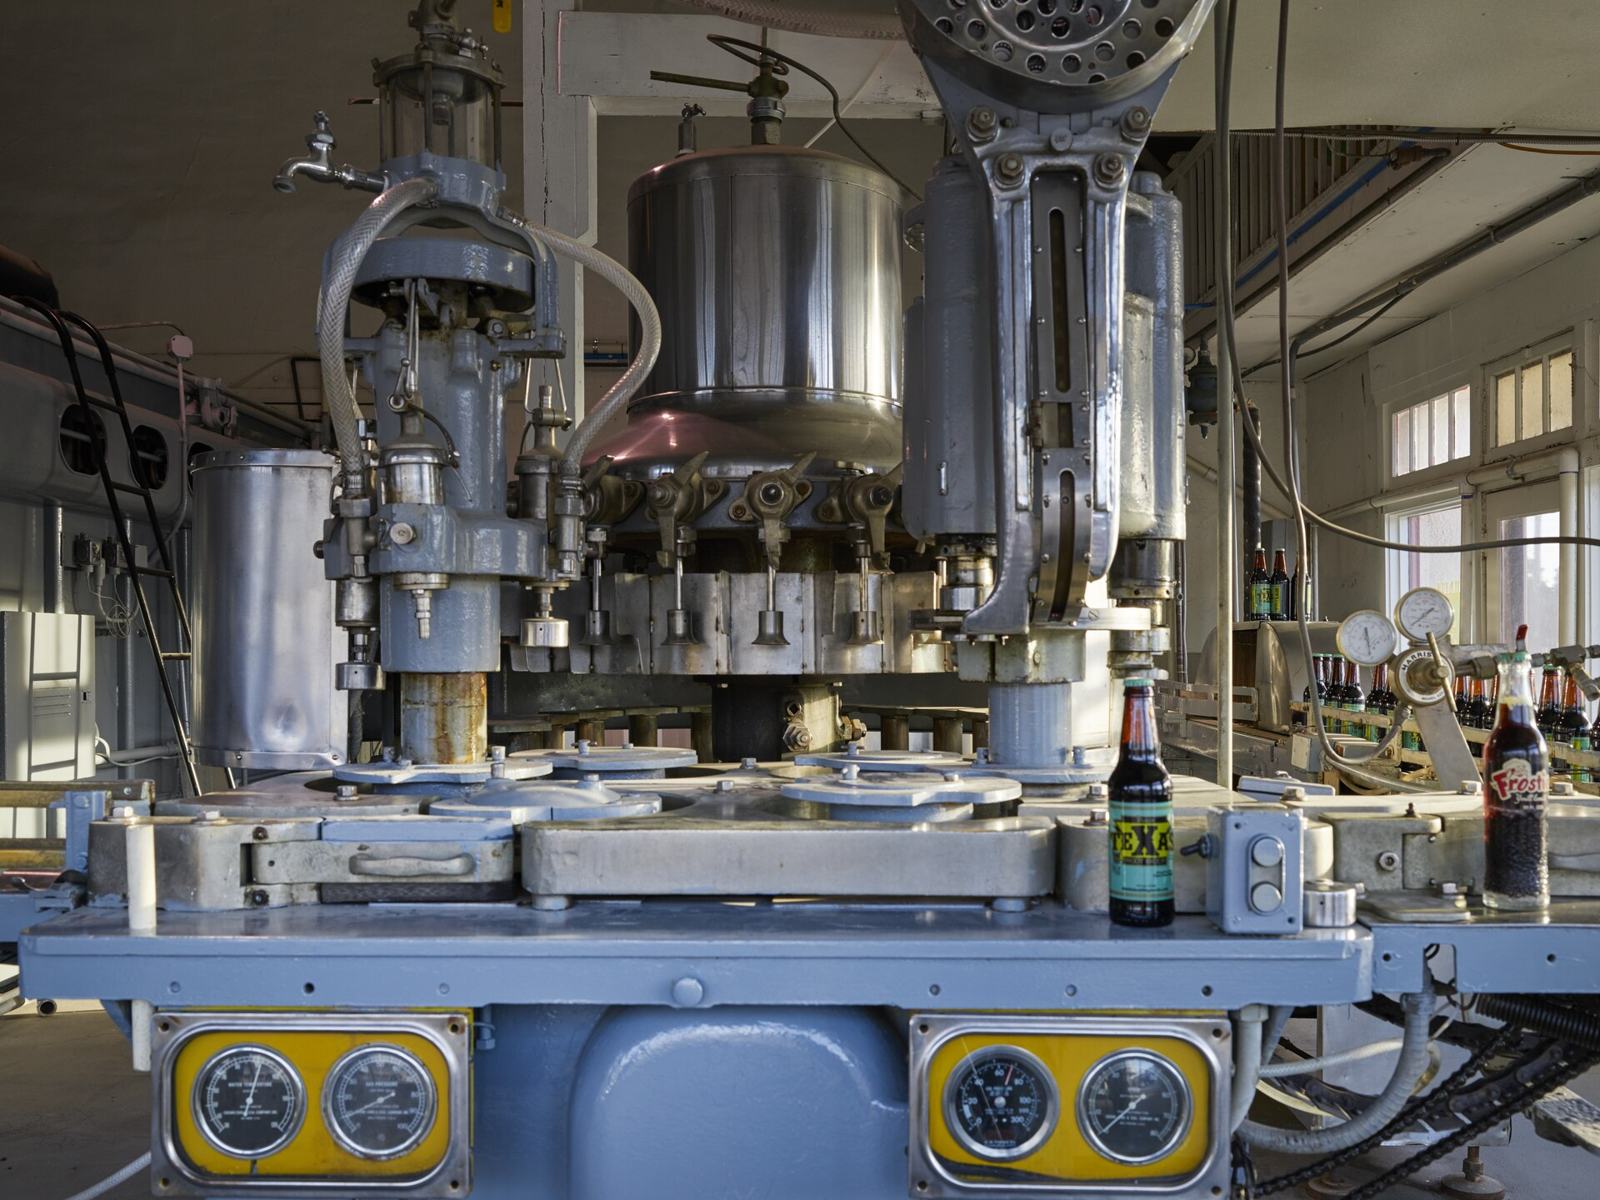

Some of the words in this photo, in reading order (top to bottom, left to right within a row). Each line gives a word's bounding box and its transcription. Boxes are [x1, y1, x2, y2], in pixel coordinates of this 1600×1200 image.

[1401, 651, 1433, 671] HARRIS
[1111, 826, 1174, 857] TEXAS
[994, 1069, 1005, 1077] 60
[974, 1078, 984, 1086] 40
[1014, 1078, 1024, 1086] 80
[968, 1097, 978, 1105] 20
[1019, 1097, 1031, 1105] 100
[976, 1117, 982, 1125] 0
[1011, 1116, 1024, 1124] 300
